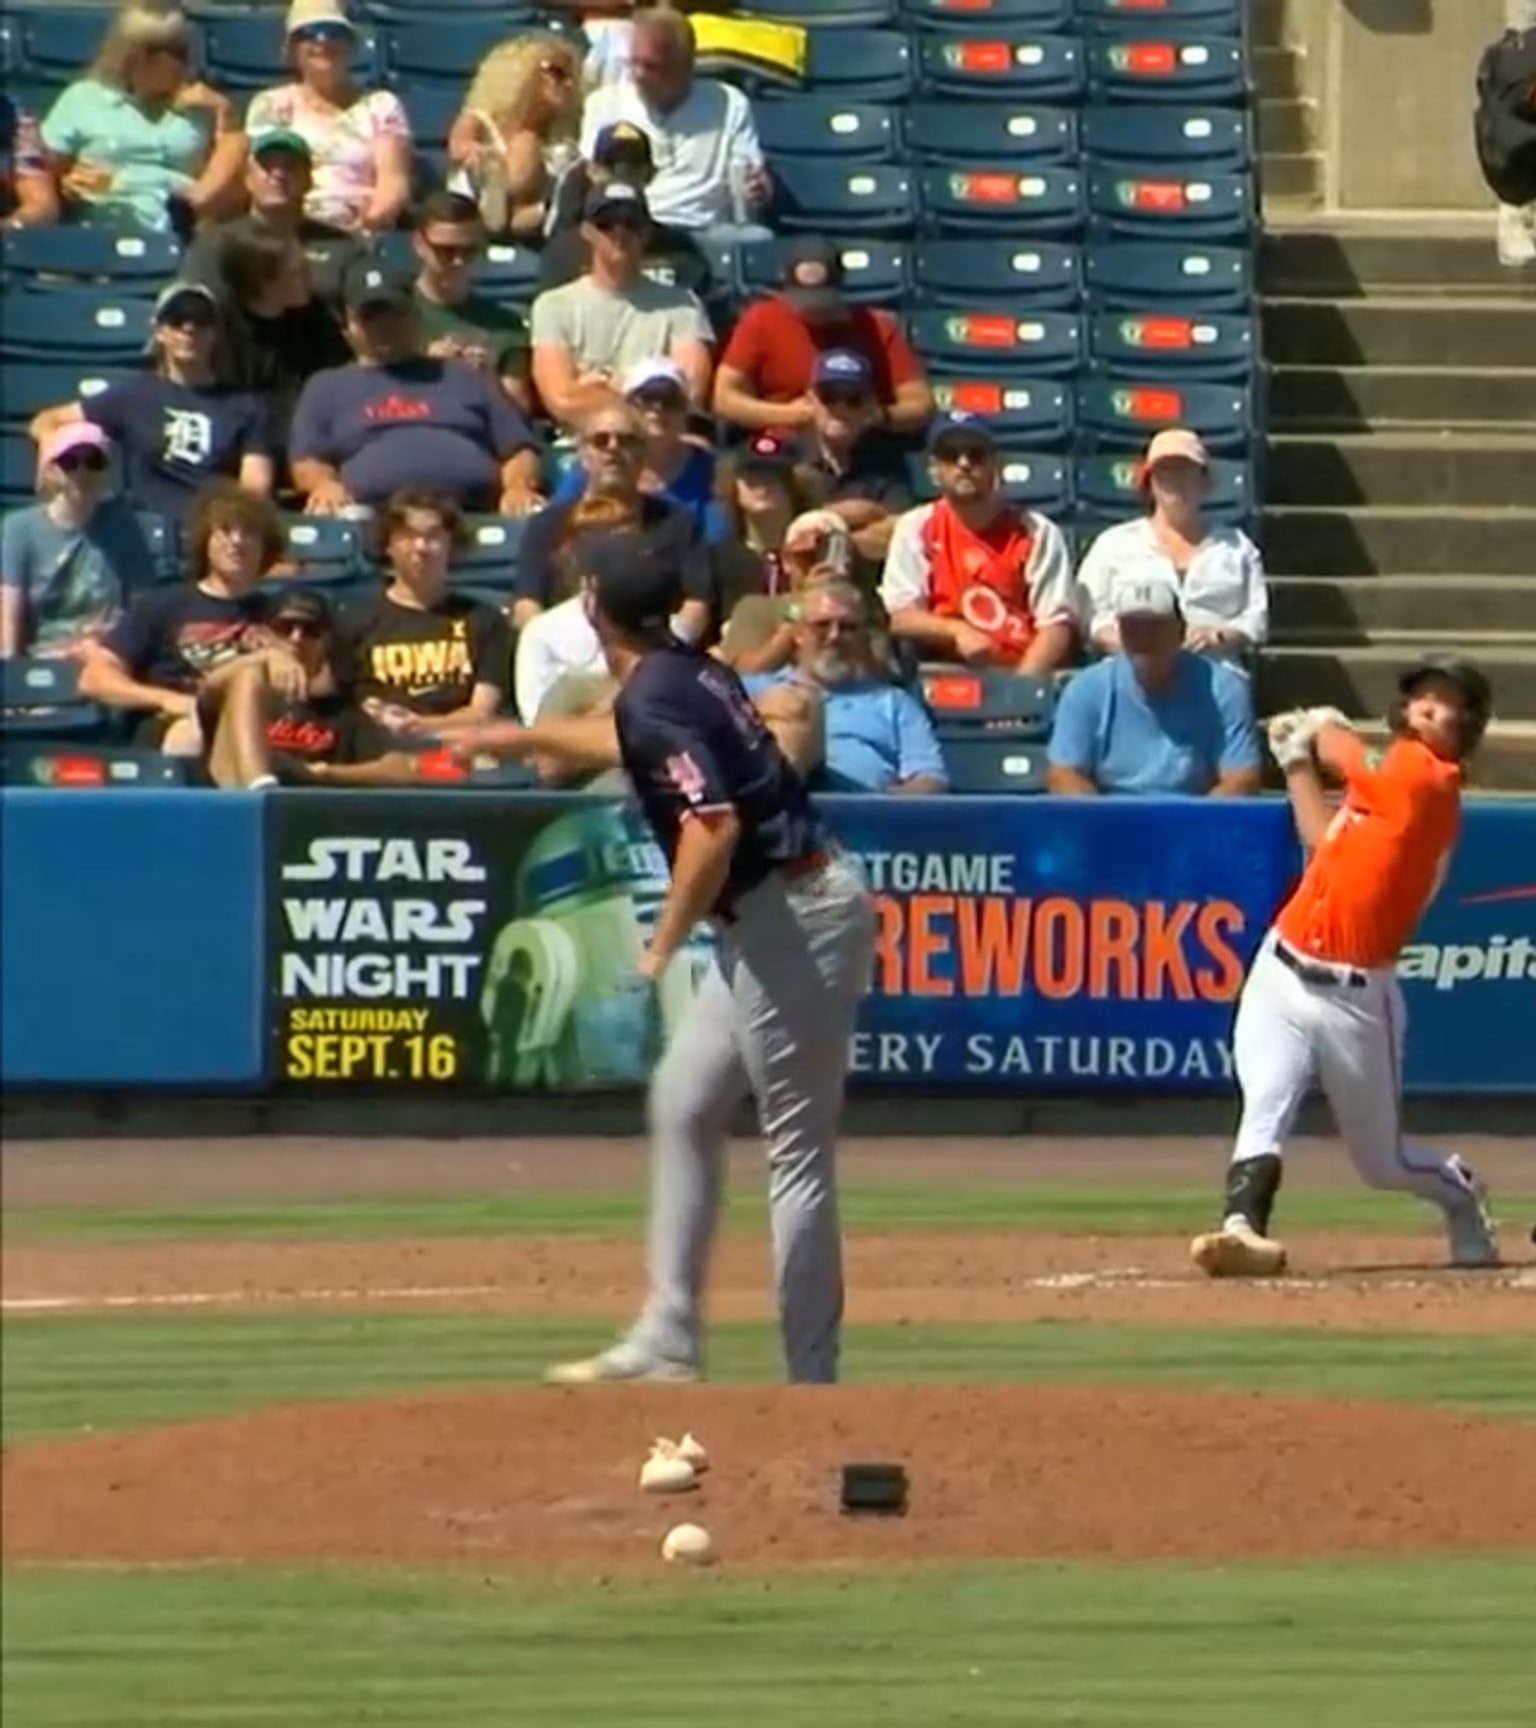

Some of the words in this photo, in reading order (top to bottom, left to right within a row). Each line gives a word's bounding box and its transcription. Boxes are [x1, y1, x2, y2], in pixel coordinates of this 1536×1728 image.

[372, 641, 472, 684] IOWA
[282, 838, 487, 882] STAR
[282, 898, 487, 943] WARS
[282, 953, 483, 998] NIGHT
[290, 1008, 430, 1032] SATURDAY
[404, 1035, 456, 1080] 16
[848, 1032, 942, 1072] ERY
[966, 1034, 1233, 1077] SATURDAY
